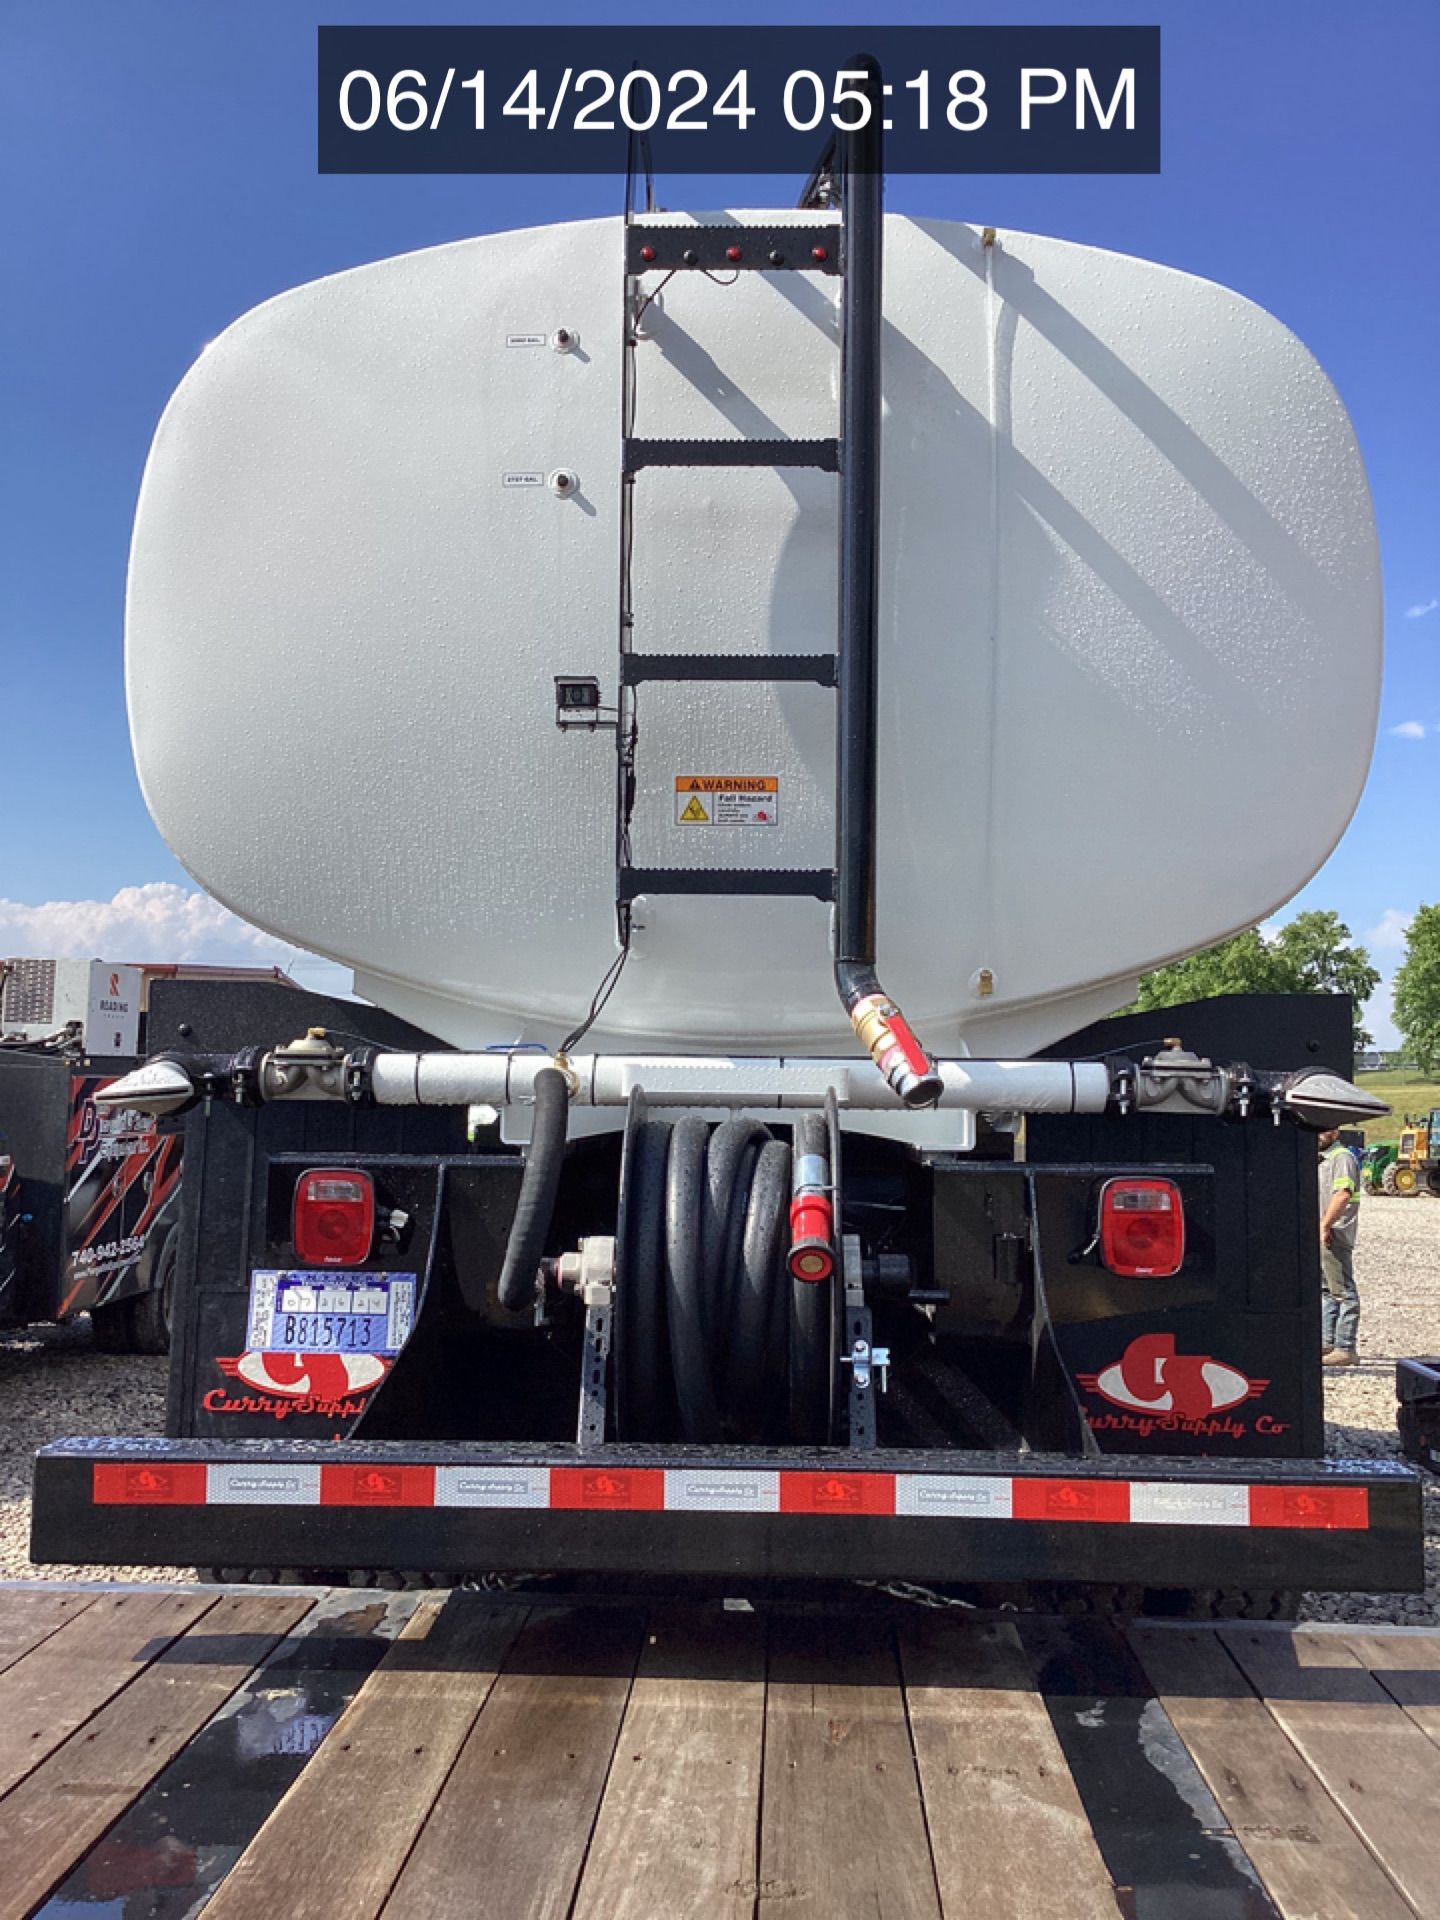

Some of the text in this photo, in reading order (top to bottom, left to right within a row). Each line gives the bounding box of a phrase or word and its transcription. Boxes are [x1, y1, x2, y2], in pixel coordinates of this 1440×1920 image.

[703, 779, 767, 791] WARNING
[718, 794, 773, 803] Fall Hazard
[285, 1315, 372, 1347] B815713
[203, 1388, 367, 1420] Curry Suppl
[1079, 1406, 1155, 1437] urry
[1156, 1413, 1247, 1440] Supply
